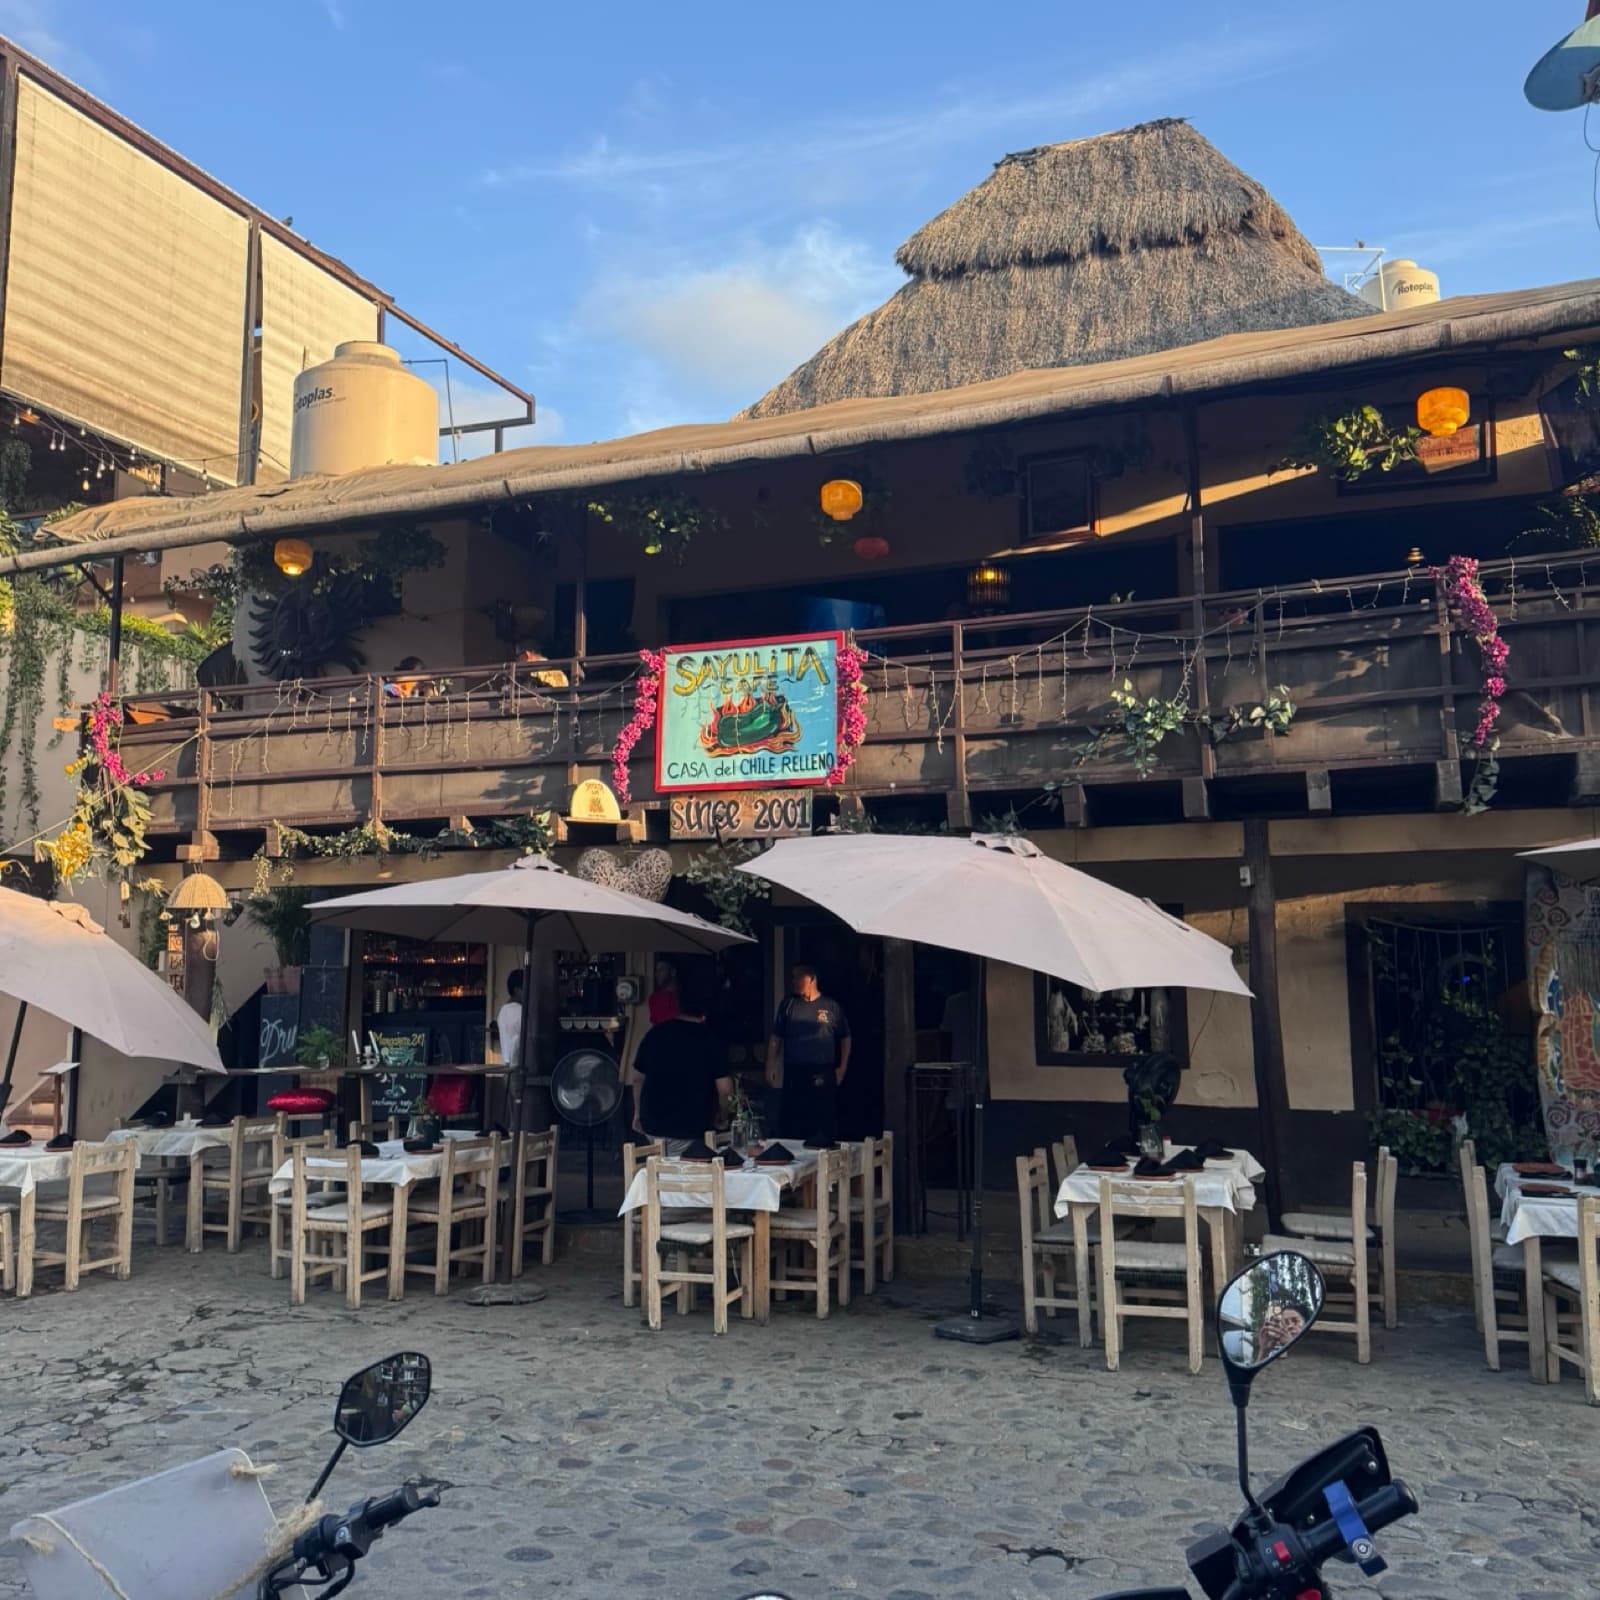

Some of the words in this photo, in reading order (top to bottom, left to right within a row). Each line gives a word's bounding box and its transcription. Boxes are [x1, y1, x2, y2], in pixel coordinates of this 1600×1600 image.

[667, 762, 709, 779] CASA
[714, 760, 736, 776] del
[740, 757, 776, 776] CHILE
[781, 752, 834, 773] RELLENO
[671, 795, 741, 834] since
[753, 797, 811, 831] 2001
